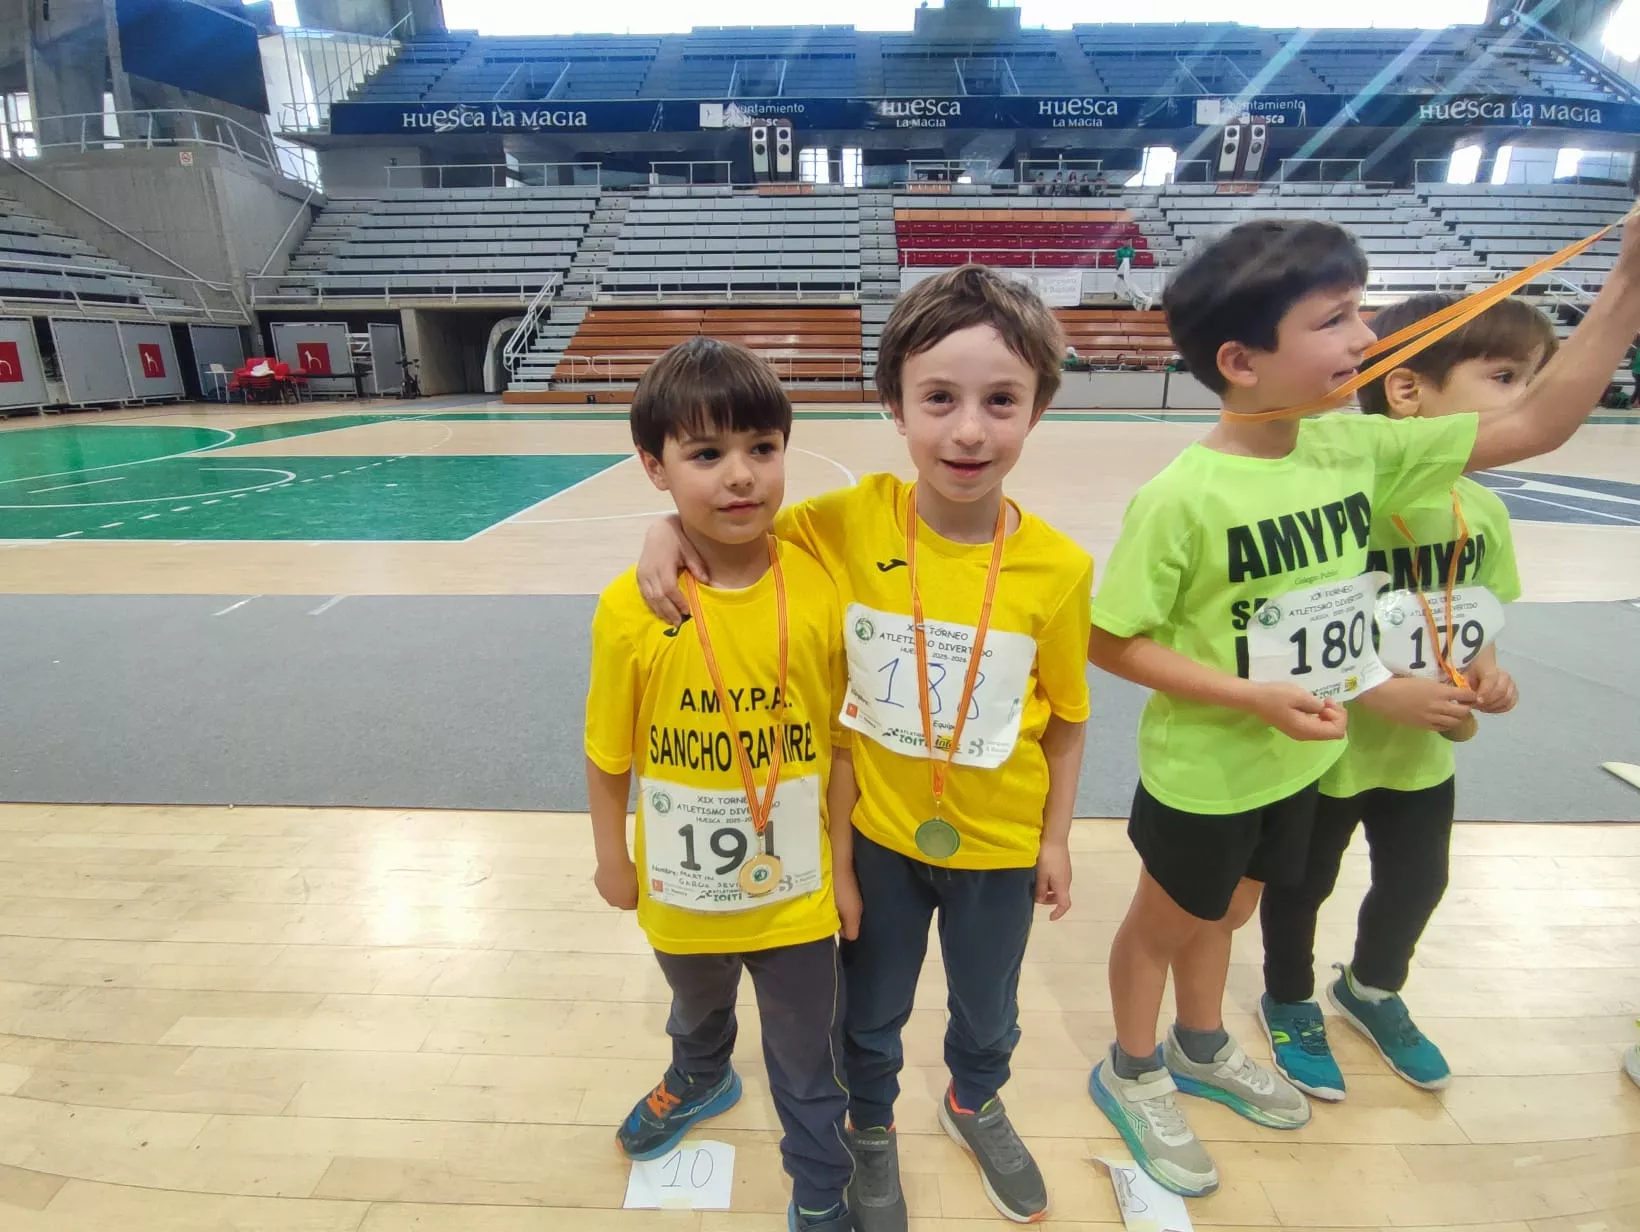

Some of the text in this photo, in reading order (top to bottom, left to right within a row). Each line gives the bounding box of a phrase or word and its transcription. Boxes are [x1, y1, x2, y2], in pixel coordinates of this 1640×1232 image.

[879, 631, 935, 648] ATLETIO
[929, 626, 969, 641] TORNEO
[1289, 610, 1365, 675] 180
[1409, 619, 1484, 669] 179
[680, 688, 792, 713] A.MY.P.A.
[650, 724, 732, 772] SANCHO
[677, 803, 725, 816] ATLETISMO
[697, 796, 748, 805] XIX TORNE
[678, 820, 780, 876] 191
[660, 1148, 714, 1188] 10
